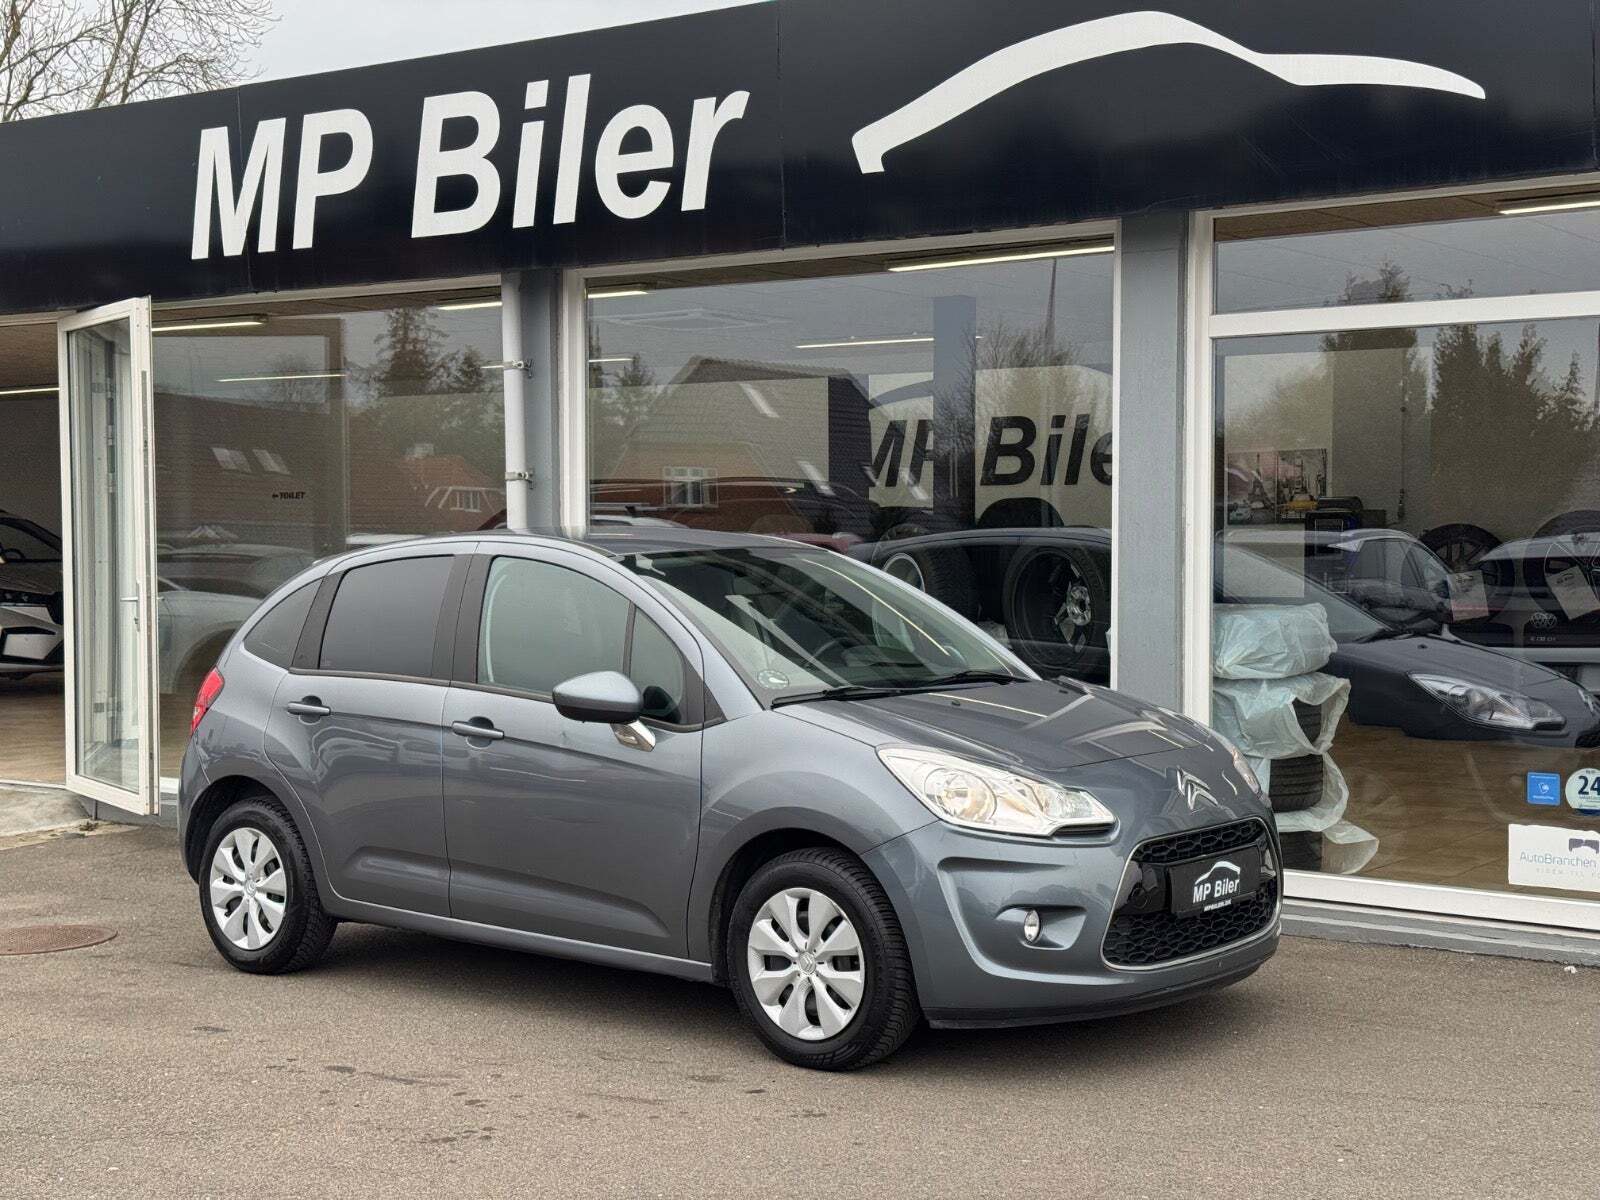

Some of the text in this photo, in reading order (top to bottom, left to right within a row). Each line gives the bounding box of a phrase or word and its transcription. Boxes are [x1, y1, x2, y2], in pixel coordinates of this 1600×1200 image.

[191, 74, 750, 260] MP Biler
[280, 491, 306, 500] TOILET
[1520, 851, 1597, 869] AutoBranchen
[1193, 878, 1239, 903] MP Biler
